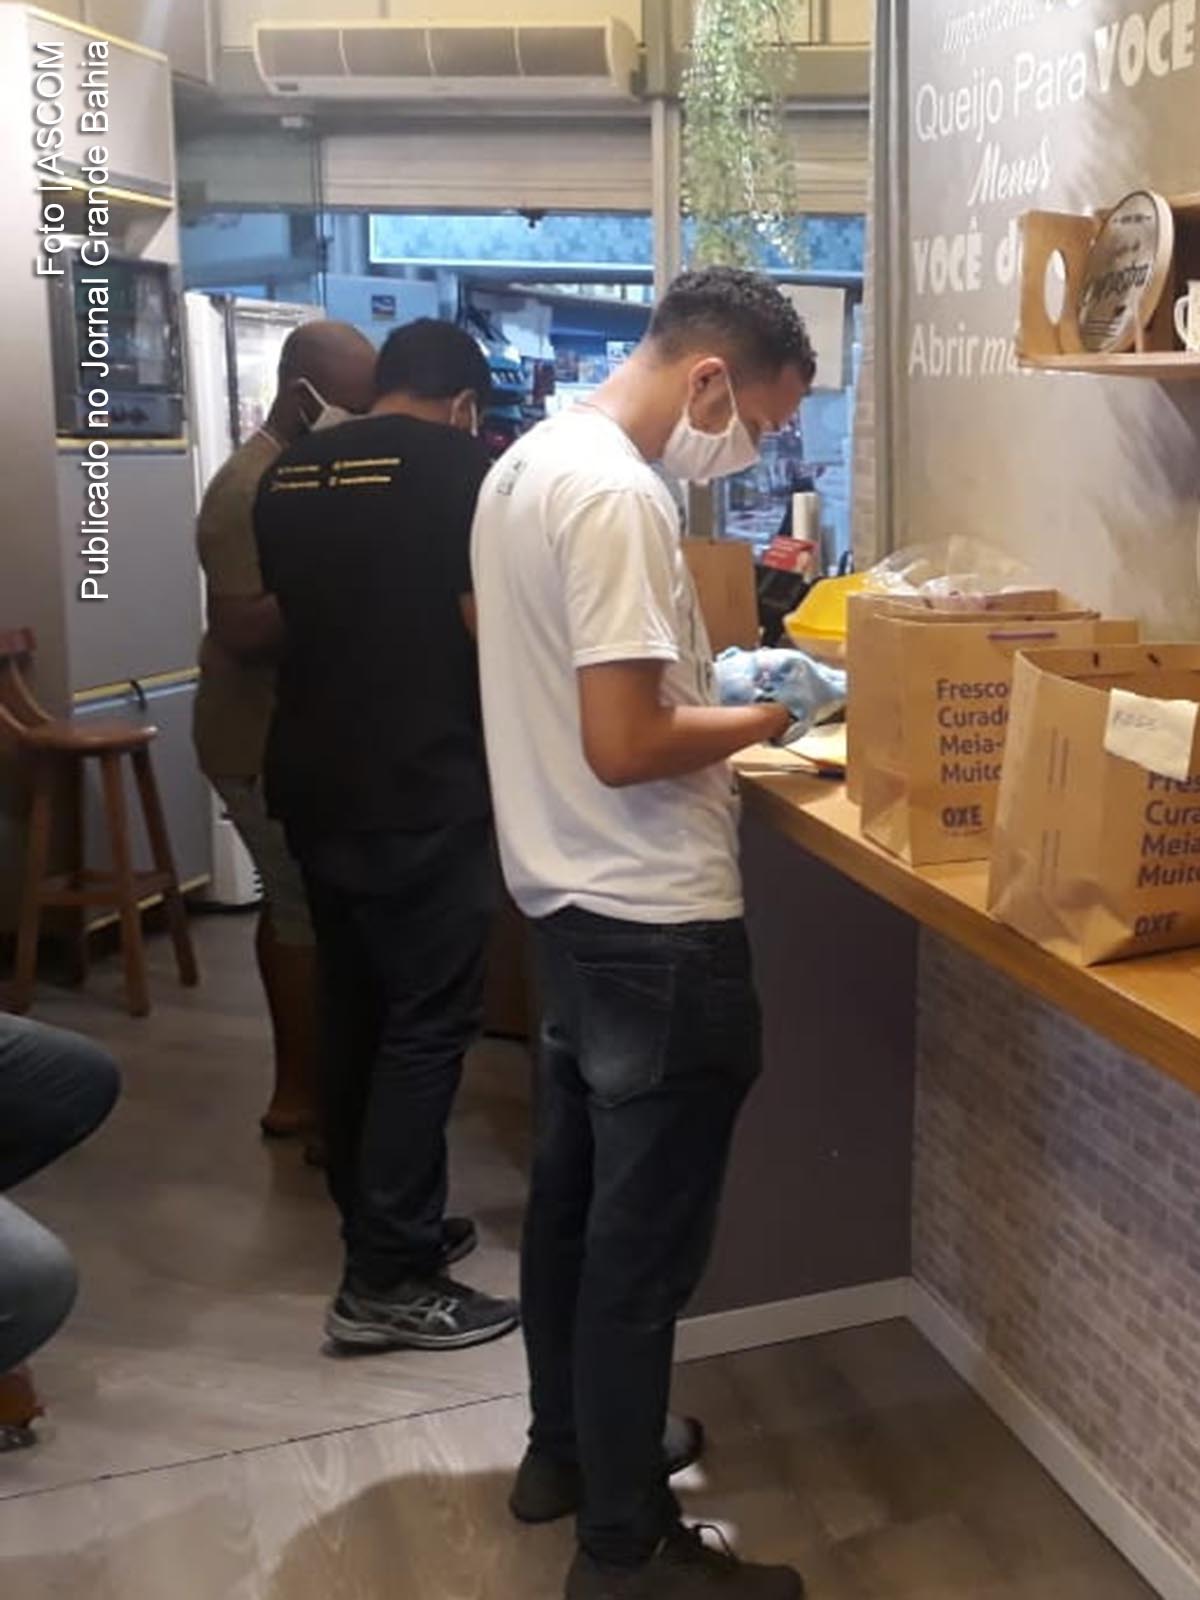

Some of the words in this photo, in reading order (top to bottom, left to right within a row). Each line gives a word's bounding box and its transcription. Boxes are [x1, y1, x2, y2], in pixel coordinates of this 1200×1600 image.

[915, 67, 1004, 143] Queijo
[1013, 51, 1087, 116] Para
[912, 216, 983, 296] VOCÊ
[908, 323, 979, 378] Abrir
[938, 734, 1004, 756] Meia-
[941, 804, 983, 828] OXE
